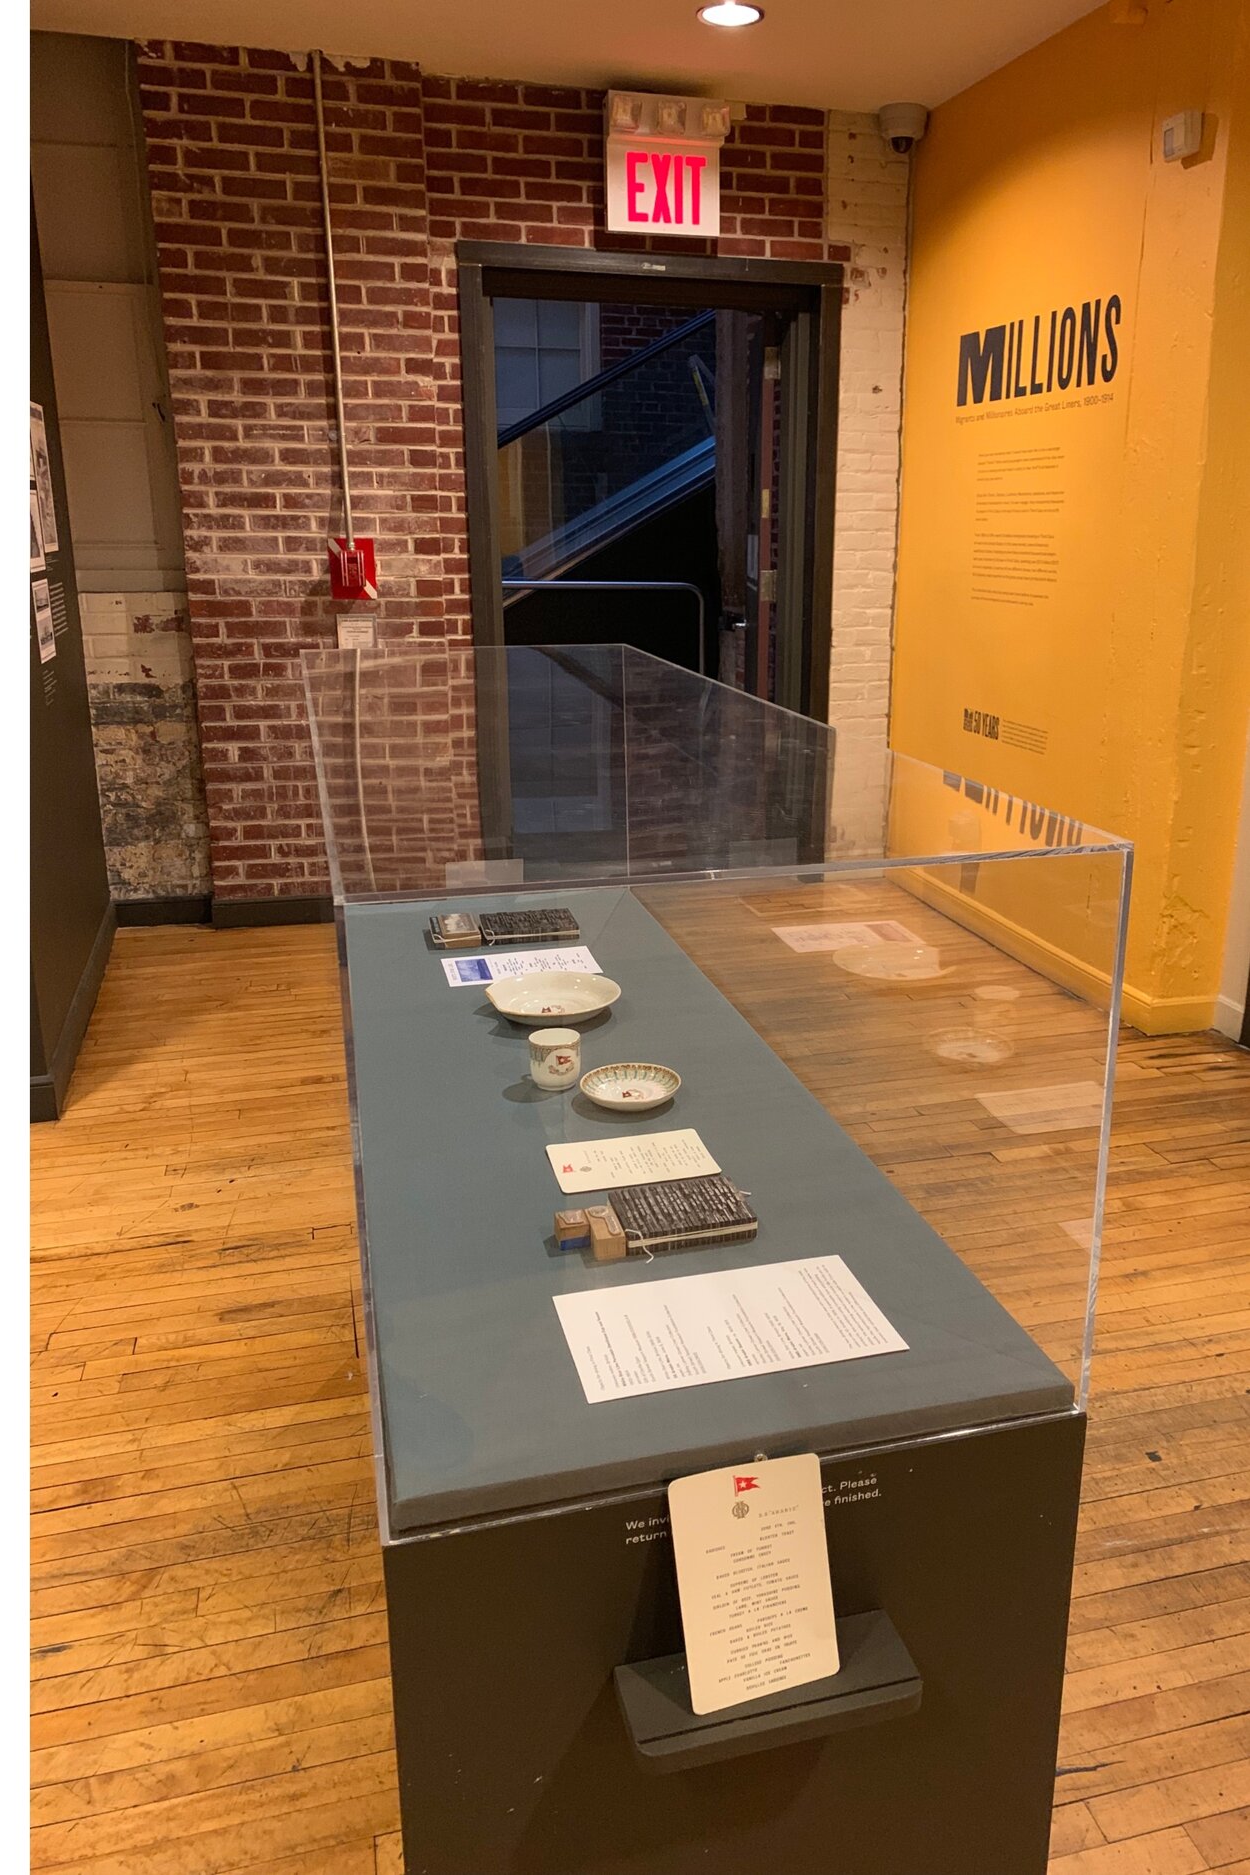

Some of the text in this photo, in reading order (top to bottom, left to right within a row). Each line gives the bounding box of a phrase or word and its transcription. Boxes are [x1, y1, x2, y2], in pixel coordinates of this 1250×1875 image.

[627, 152, 706, 225] EXIT
[956, 294, 1122, 407] MILLIONS
[839, 1477, 877, 1490] Please
[834, 1488, 882, 1505] finished.
[625, 1519, 645, 1531] We
[625, 1531, 667, 1545] return
